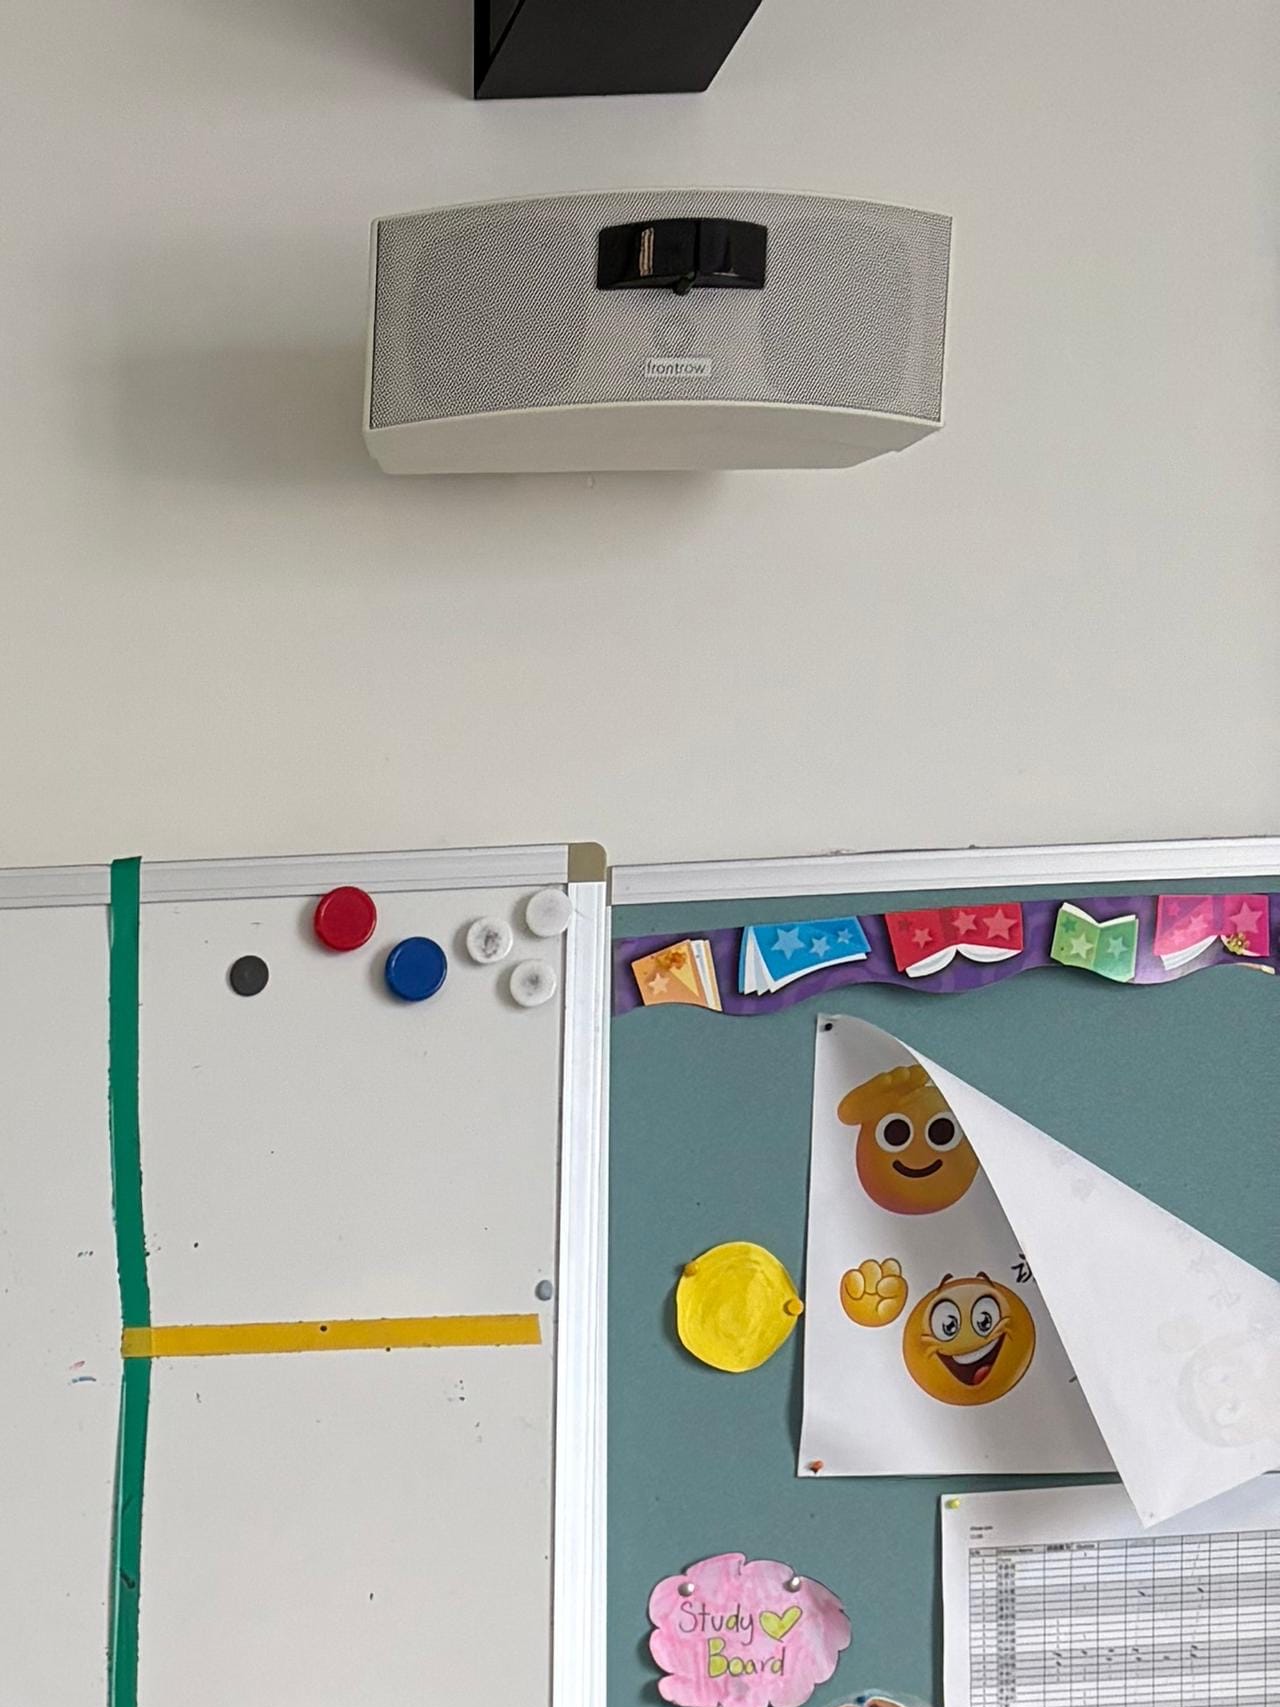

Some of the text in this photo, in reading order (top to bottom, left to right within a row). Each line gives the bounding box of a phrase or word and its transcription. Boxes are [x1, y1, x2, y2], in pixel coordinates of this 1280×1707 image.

[647, 360, 706, 374] frontrow
[678, 1601, 754, 1646] Study
[707, 1637, 786, 1678] Board
